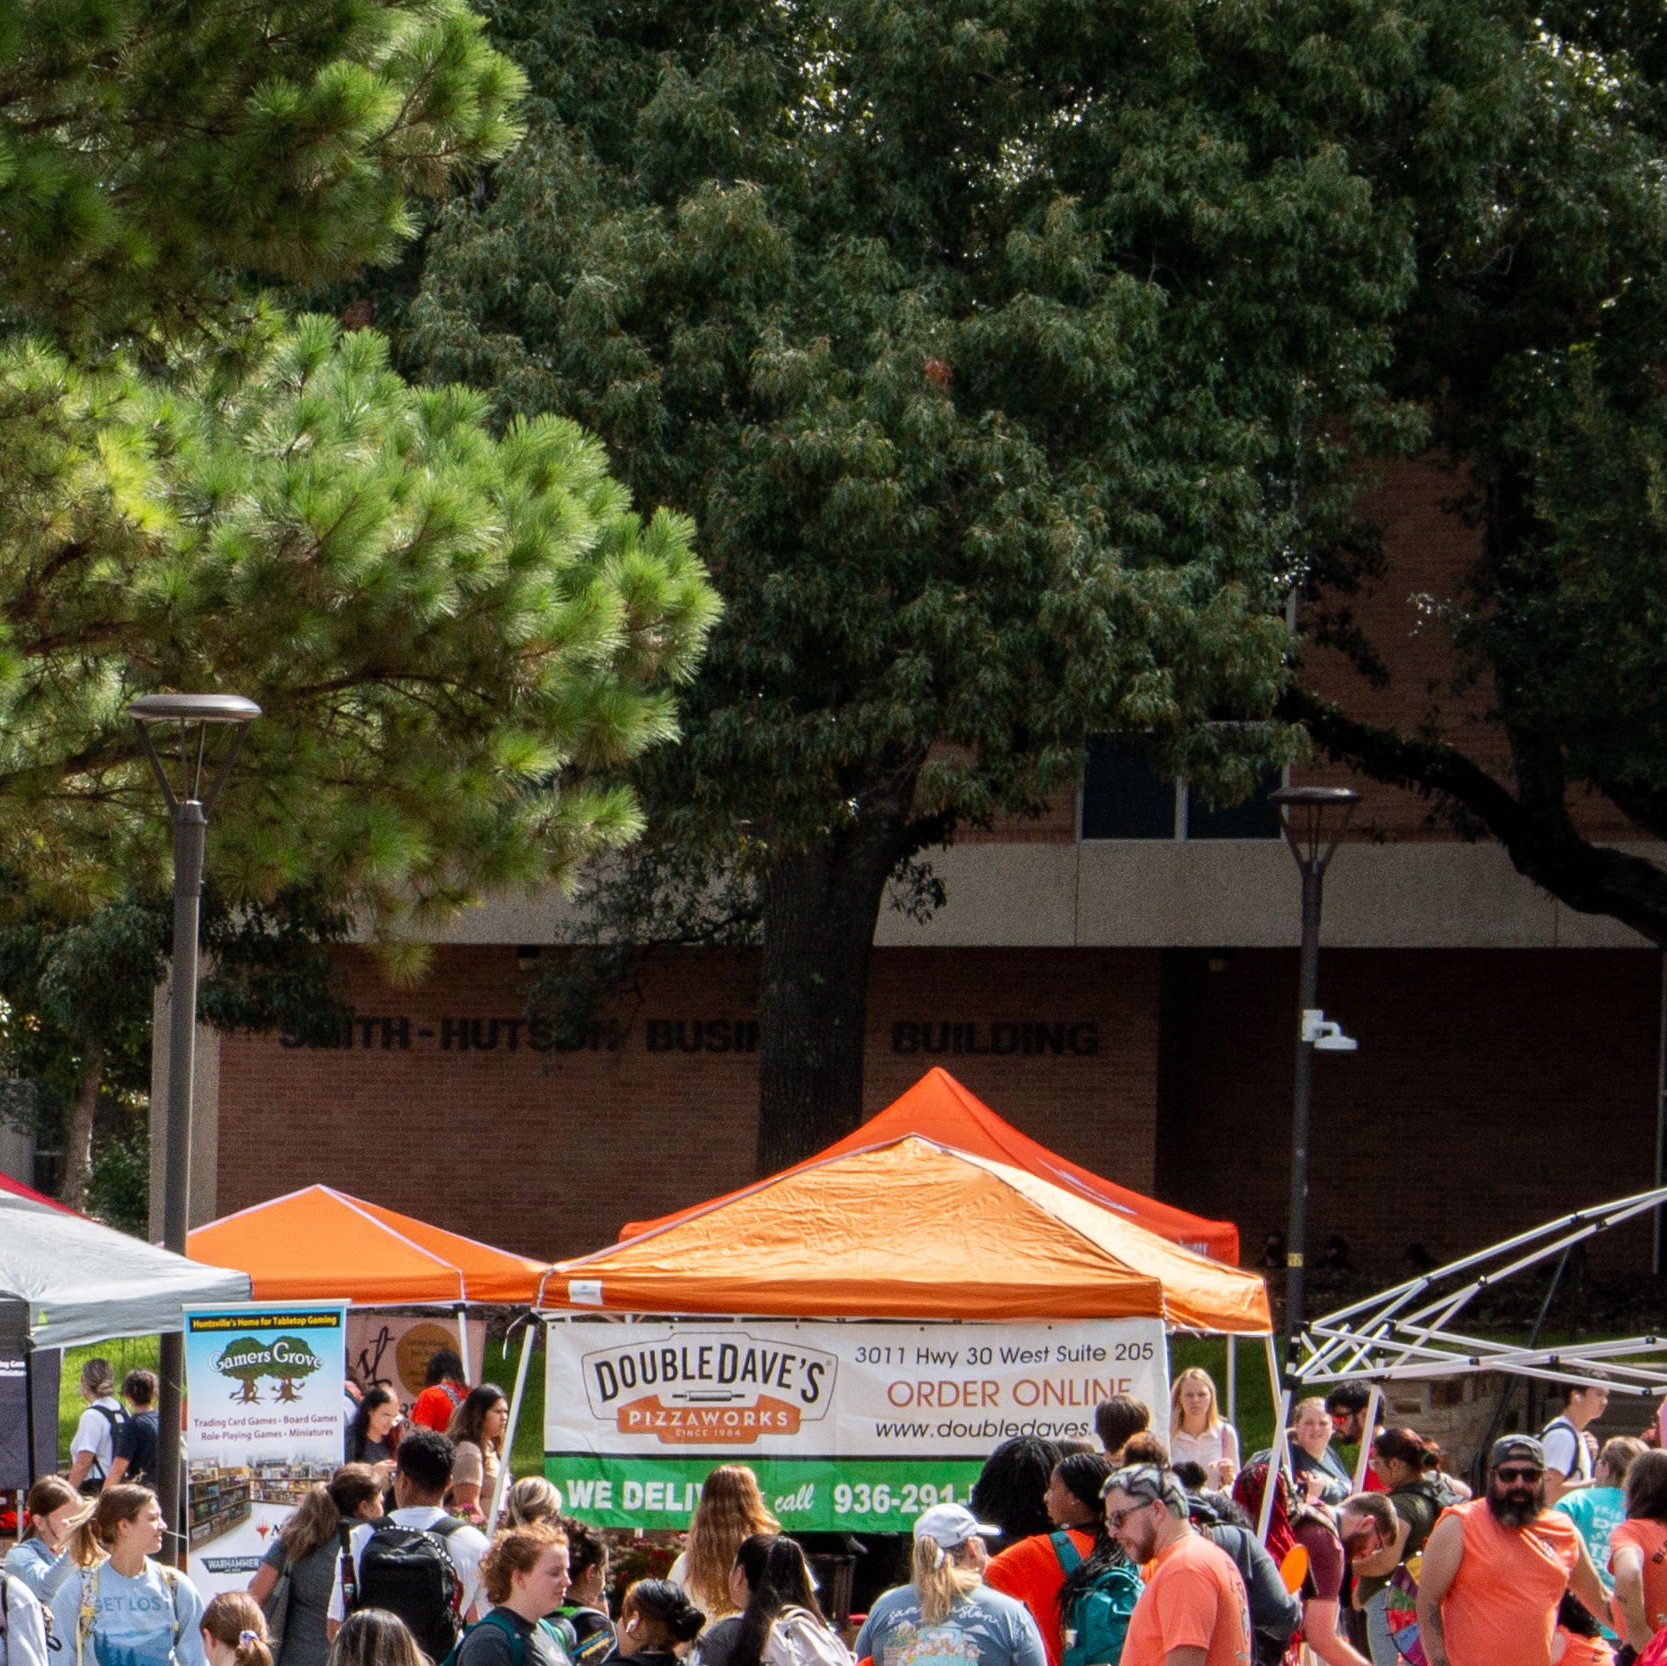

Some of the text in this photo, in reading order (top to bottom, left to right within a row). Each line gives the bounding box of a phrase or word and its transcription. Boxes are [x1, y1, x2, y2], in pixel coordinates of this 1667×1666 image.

[892, 1020, 1100, 1056] BUILDING
[192, 1315, 337, 1329] Huntsville's Home for Tabletop Gaming
[208, 1341, 323, 1373] Gamers Grove
[854, 1342, 1155, 1369] 3011 Hwy 30 West Suite 205
[886, 1379, 1001, 1408] ORDER
[194, 1414, 338, 1430] Trading Card Games Board Games
[629, 1409, 789, 1427] PIZZAWORKS
[201, 1428, 334, 1442] Role-Playing Games Miniatures
[674, 1428, 742, 1437] SINCE 1984
[875, 1418, 1093, 1439] www.doubledaves.
[567, 1480, 613, 1510] WE
[775, 1482, 816, 1514] call
[207, 1558, 260, 1569] WARHAMMER
